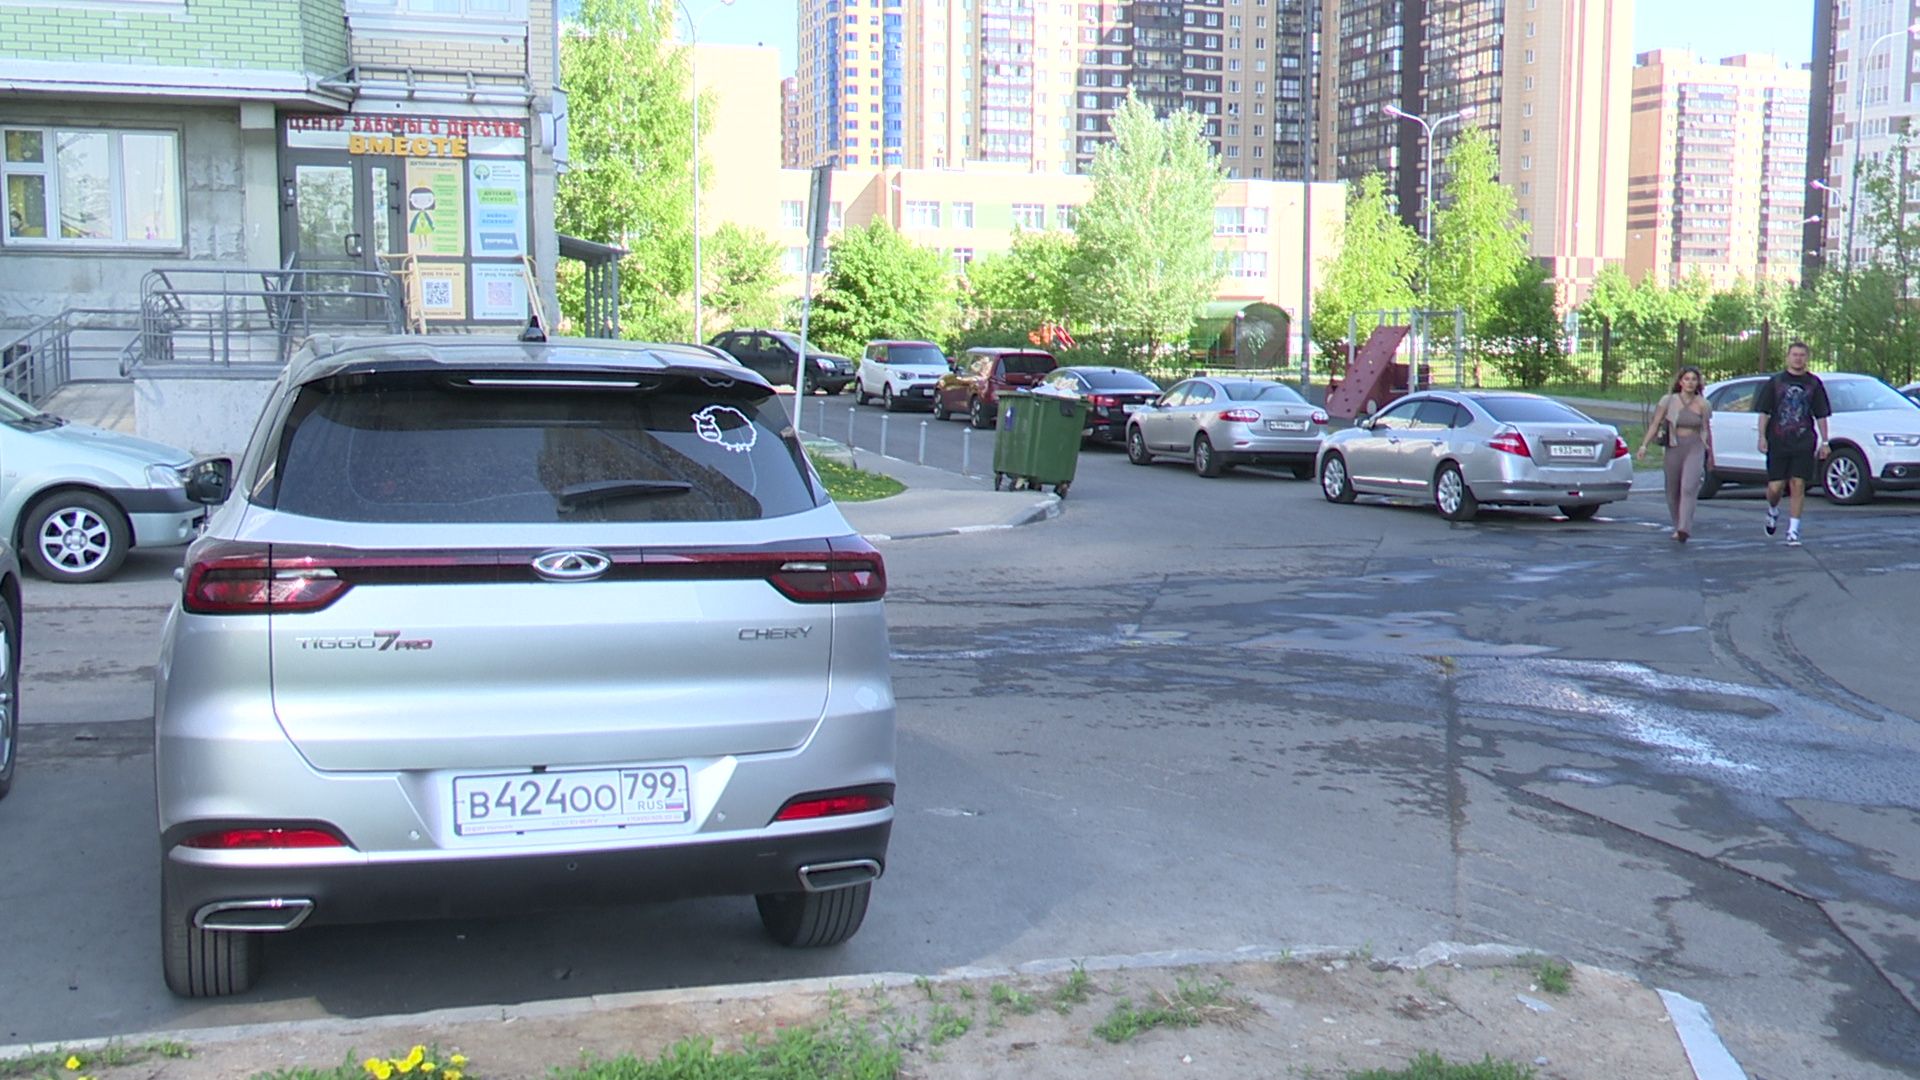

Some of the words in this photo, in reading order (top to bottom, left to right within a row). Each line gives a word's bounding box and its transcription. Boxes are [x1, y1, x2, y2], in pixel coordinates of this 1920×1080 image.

[289, 114, 344, 133] ЦЕНТР
[352, 116, 422, 133] ЗАБОТЫ
[430, 118, 439, 134] О
[447, 118, 522, 138] ДЕТСТВЕ
[349, 134, 467, 157] ВМЕСТЕ
[738, 626, 812, 640] CHERY
[623, 771, 677, 800] 799
[638, 800, 665, 811] RUS
